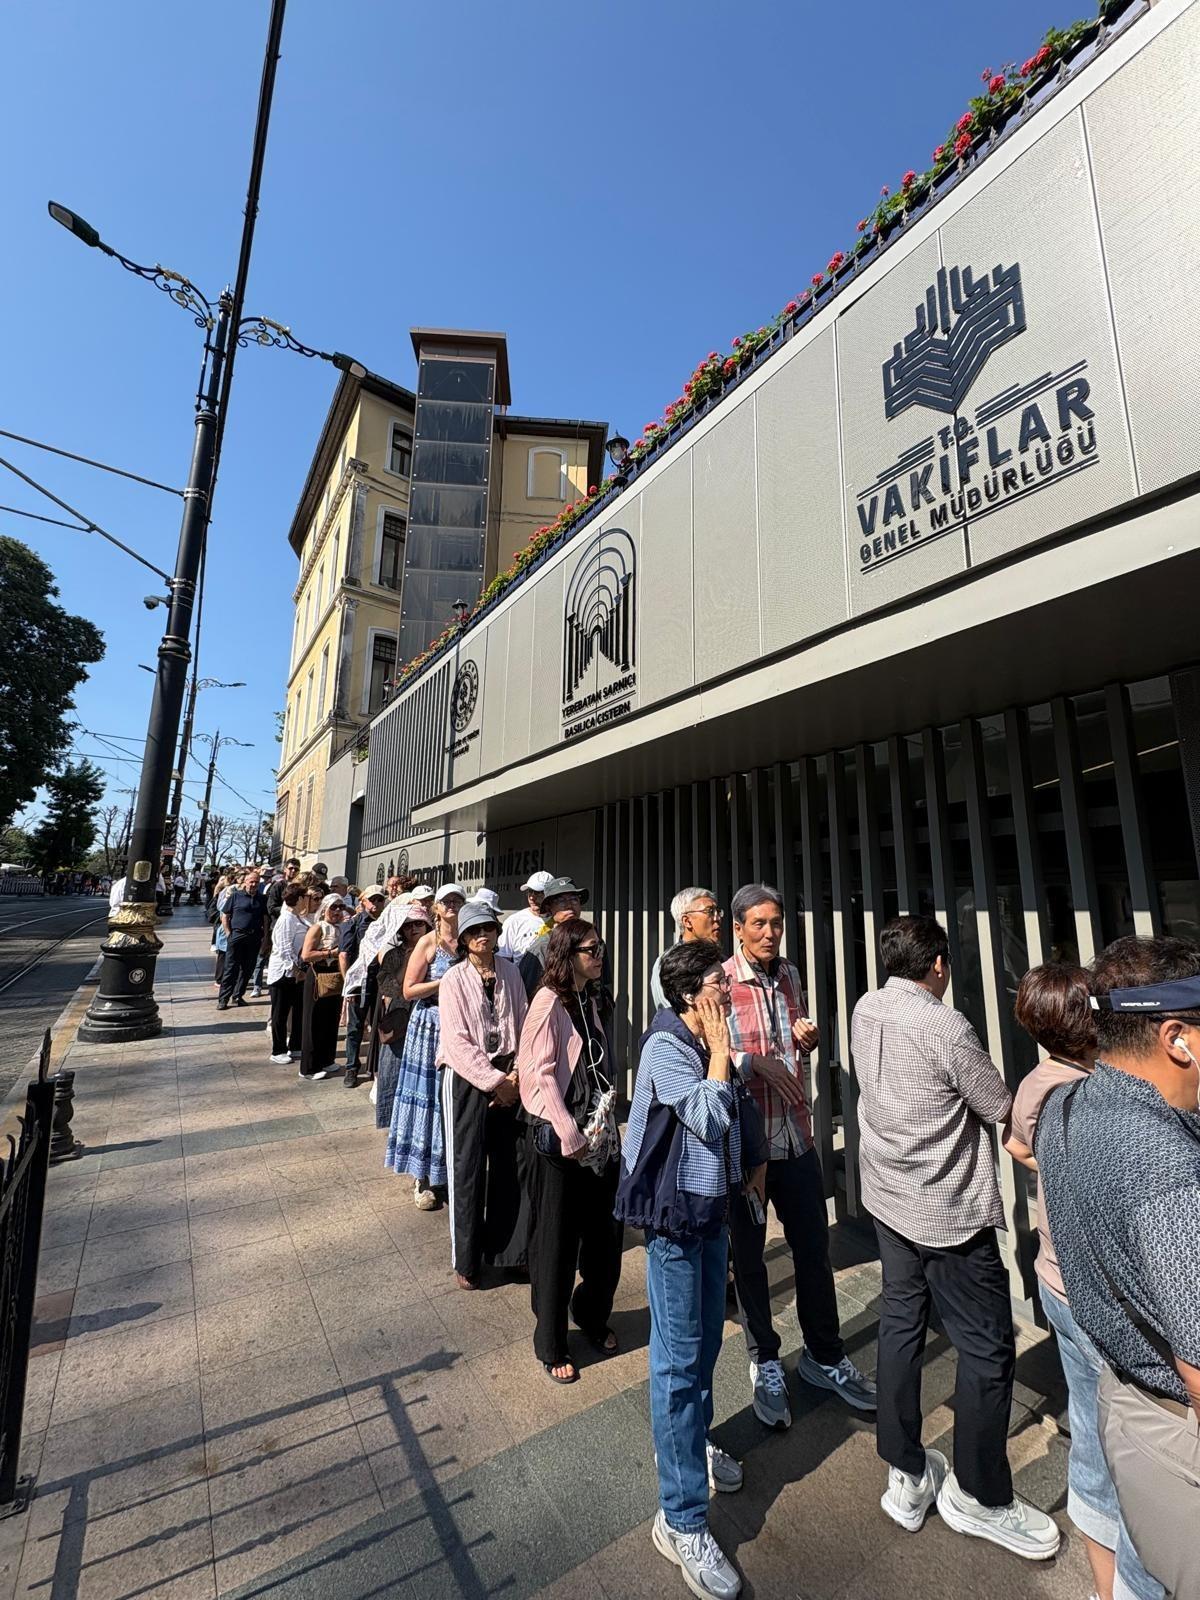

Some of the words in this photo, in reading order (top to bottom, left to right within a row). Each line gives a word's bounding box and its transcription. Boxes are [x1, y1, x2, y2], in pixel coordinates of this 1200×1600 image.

[857, 377, 1096, 538] VAKIFLAR
[860, 519, 921, 563] GENEL
[931, 420, 1097, 530] MÜDÜRLÜĞÜ
[562, 690, 602, 719] YEREBATAN
[603, 673, 636, 699] SARNICI
[564, 717, 596, 739] BASILICA
[597, 701, 631, 725] CISTERN
